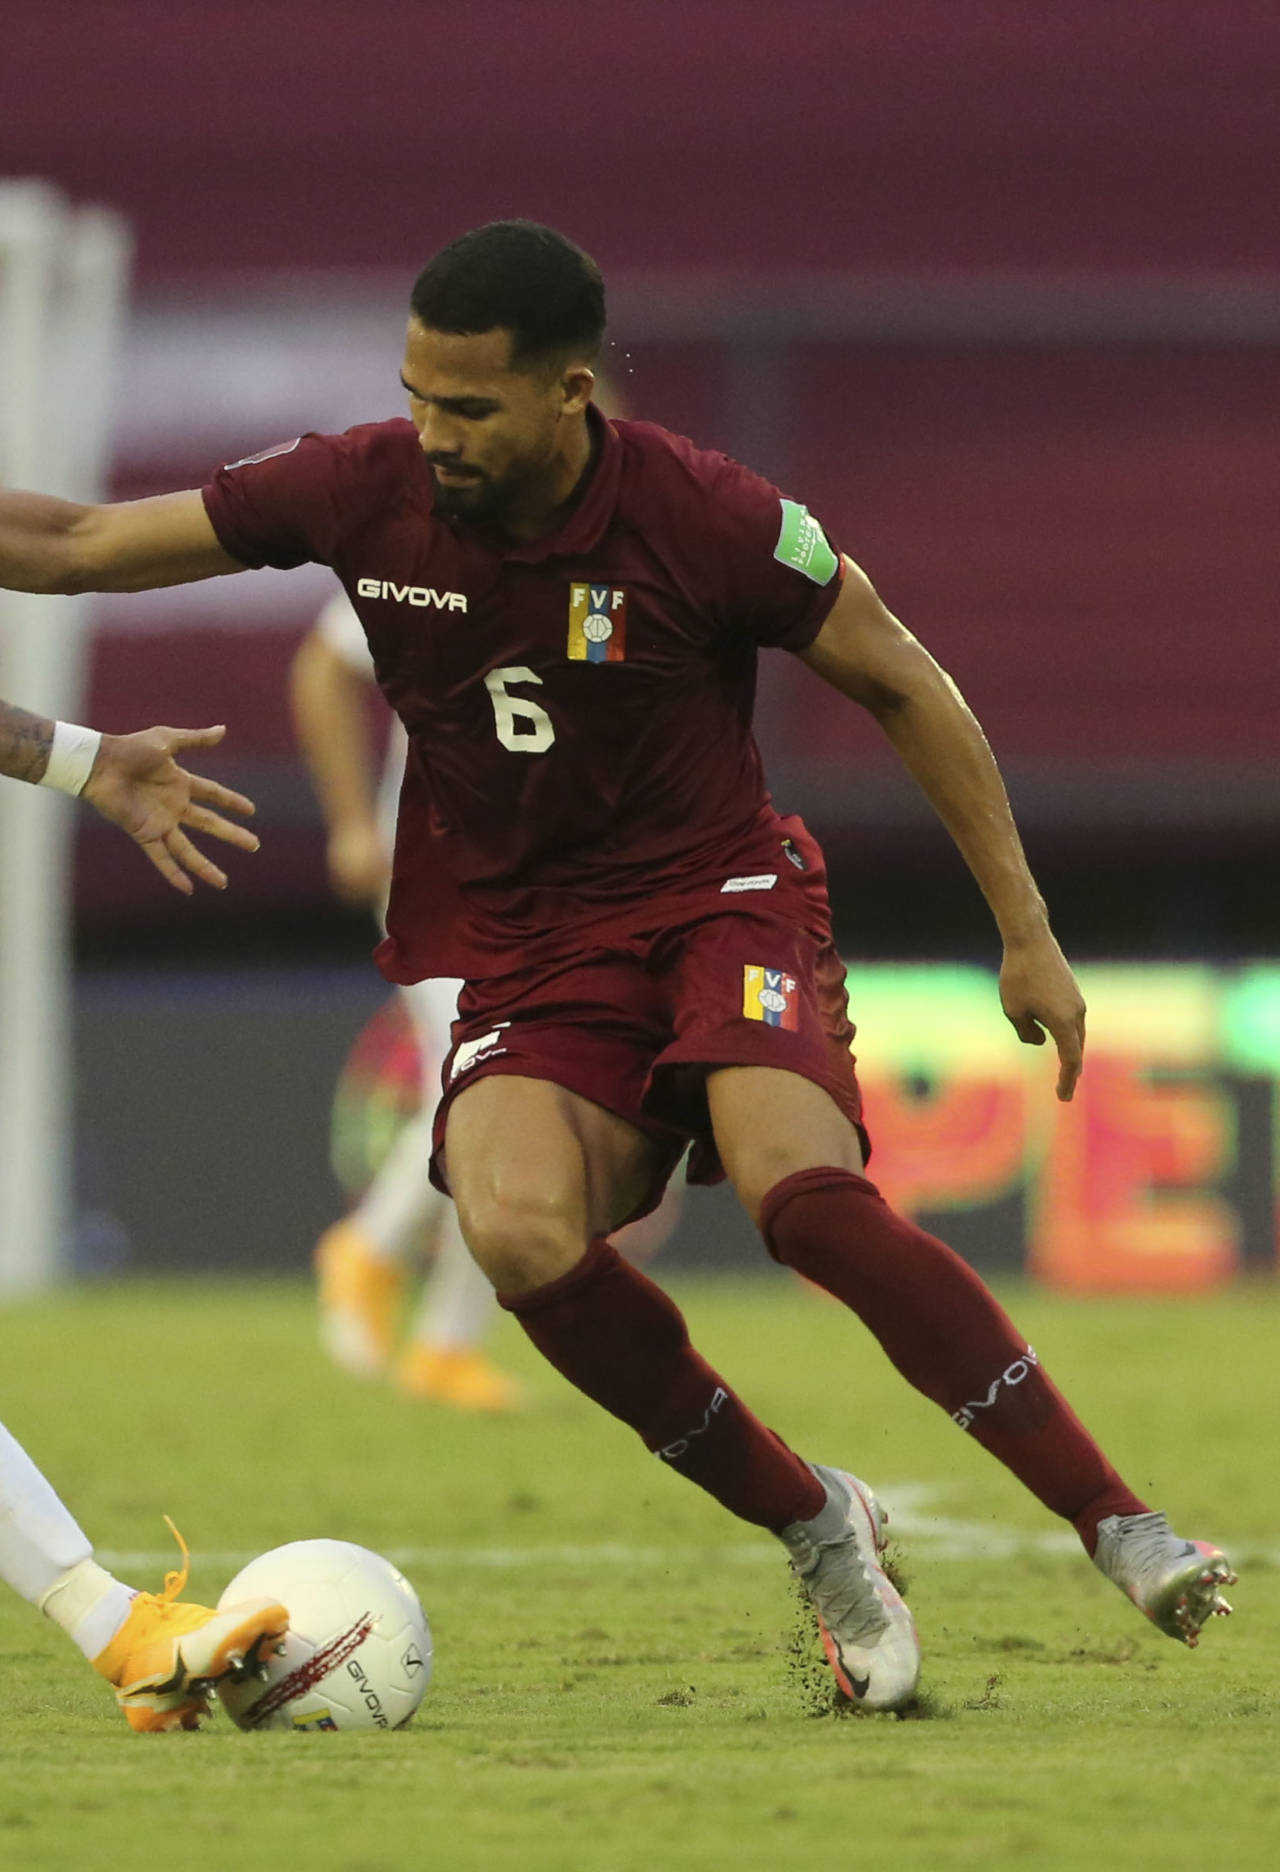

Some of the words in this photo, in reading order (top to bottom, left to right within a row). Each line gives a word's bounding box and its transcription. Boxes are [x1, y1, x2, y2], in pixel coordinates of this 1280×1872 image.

[356, 577, 468, 613] GIVOVA
[572, 588, 625, 611] FVF
[483, 665, 556, 753] 6
[748, 968, 797, 993] FVF
